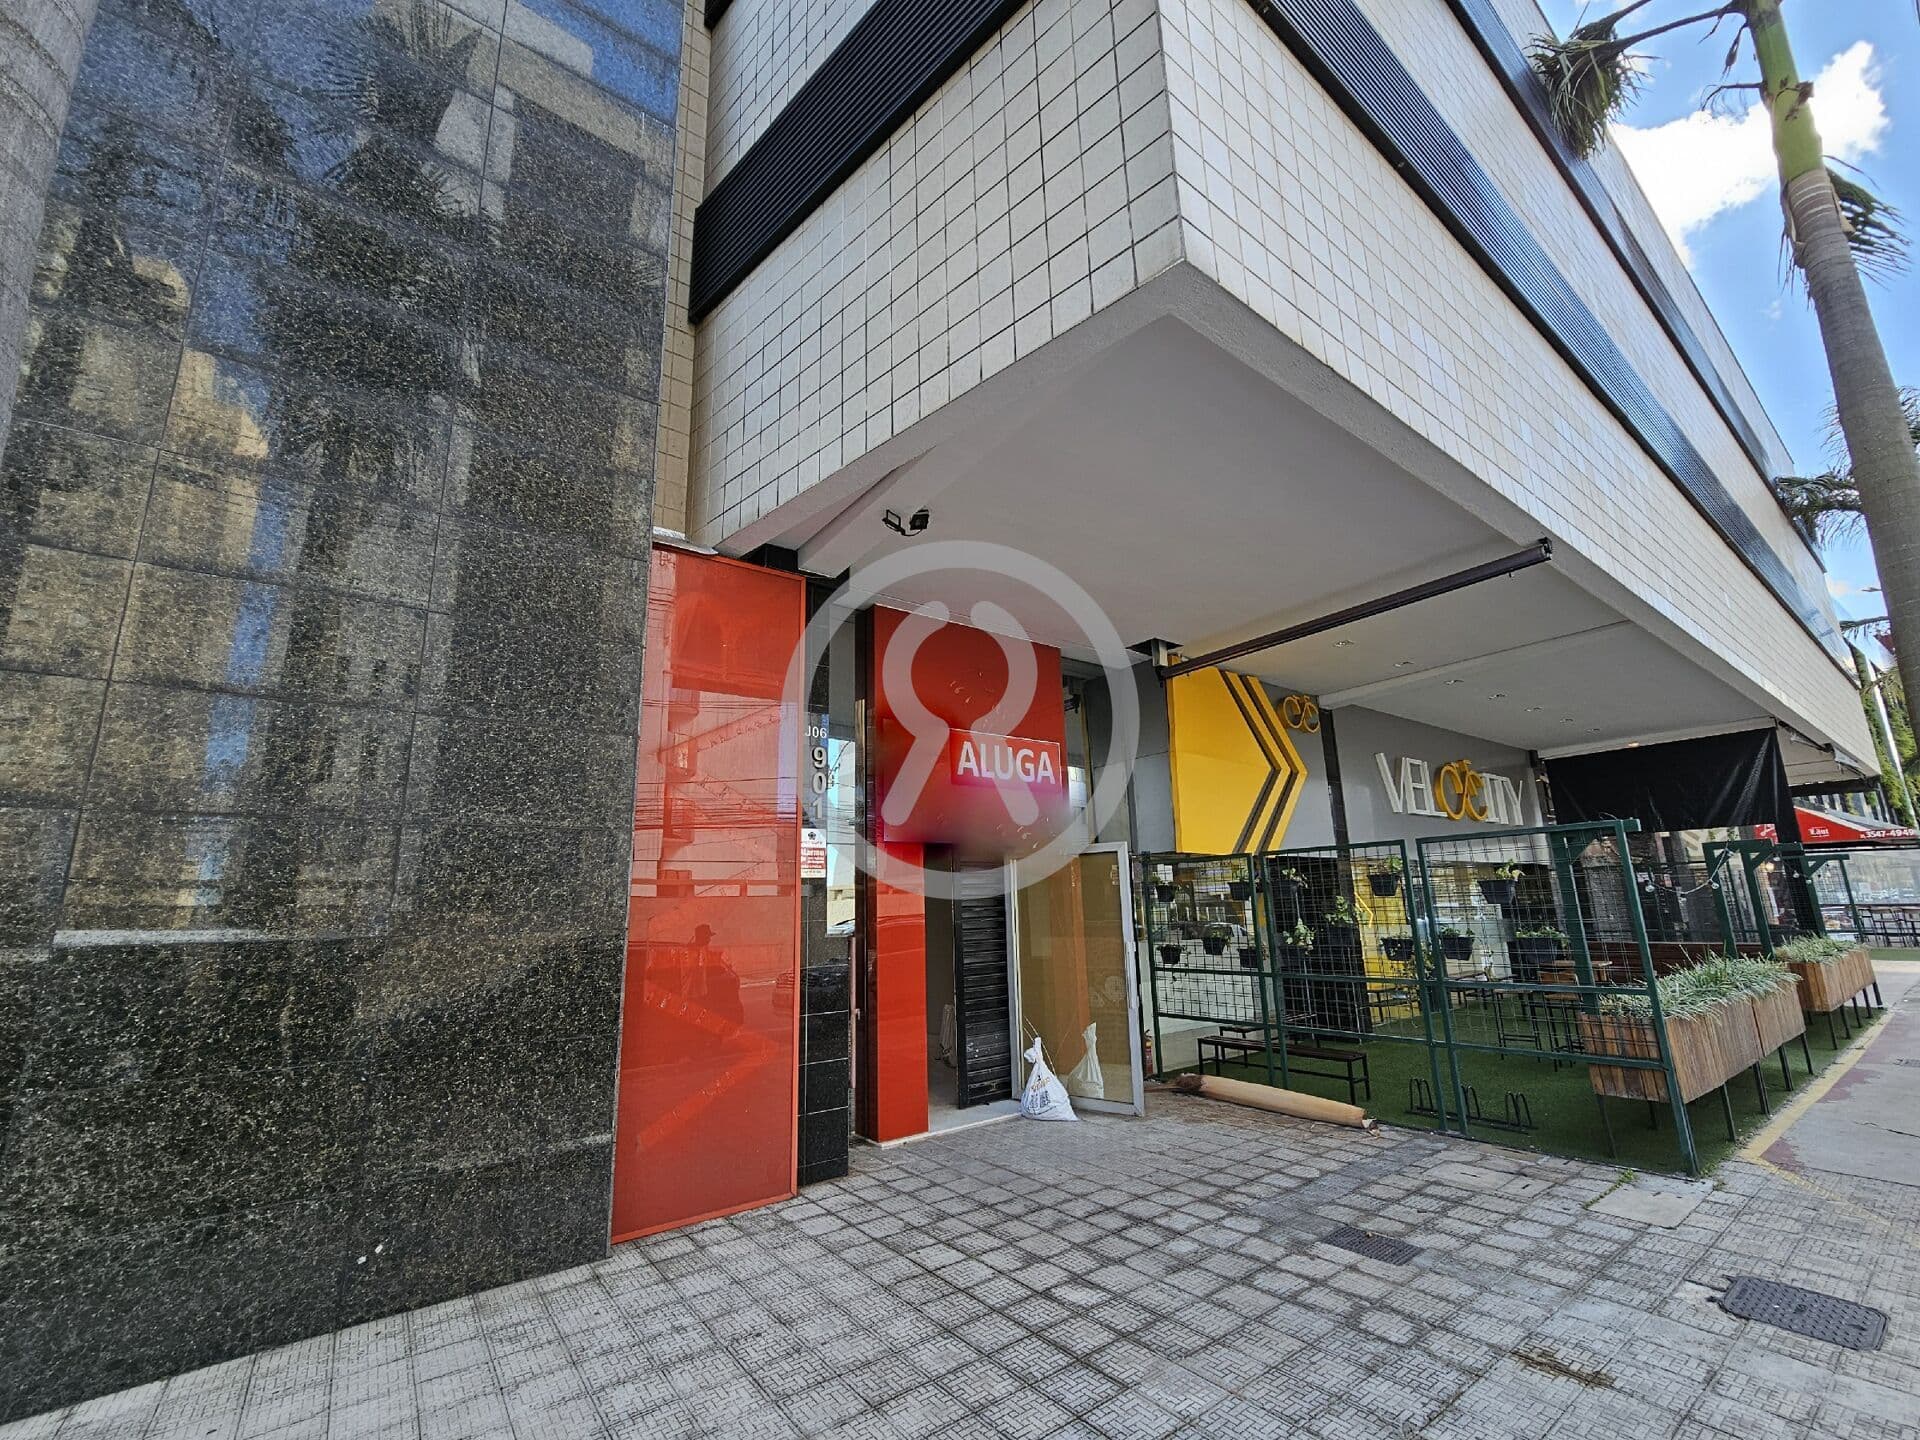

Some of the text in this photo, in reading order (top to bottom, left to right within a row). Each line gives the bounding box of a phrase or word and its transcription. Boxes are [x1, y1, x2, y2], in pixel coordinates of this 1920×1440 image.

[805, 725, 827, 738] J06
[812, 746, 827, 819] 901
[957, 741, 1056, 785] ALUGA
[1375, 752, 1524, 826] VELOCITY
